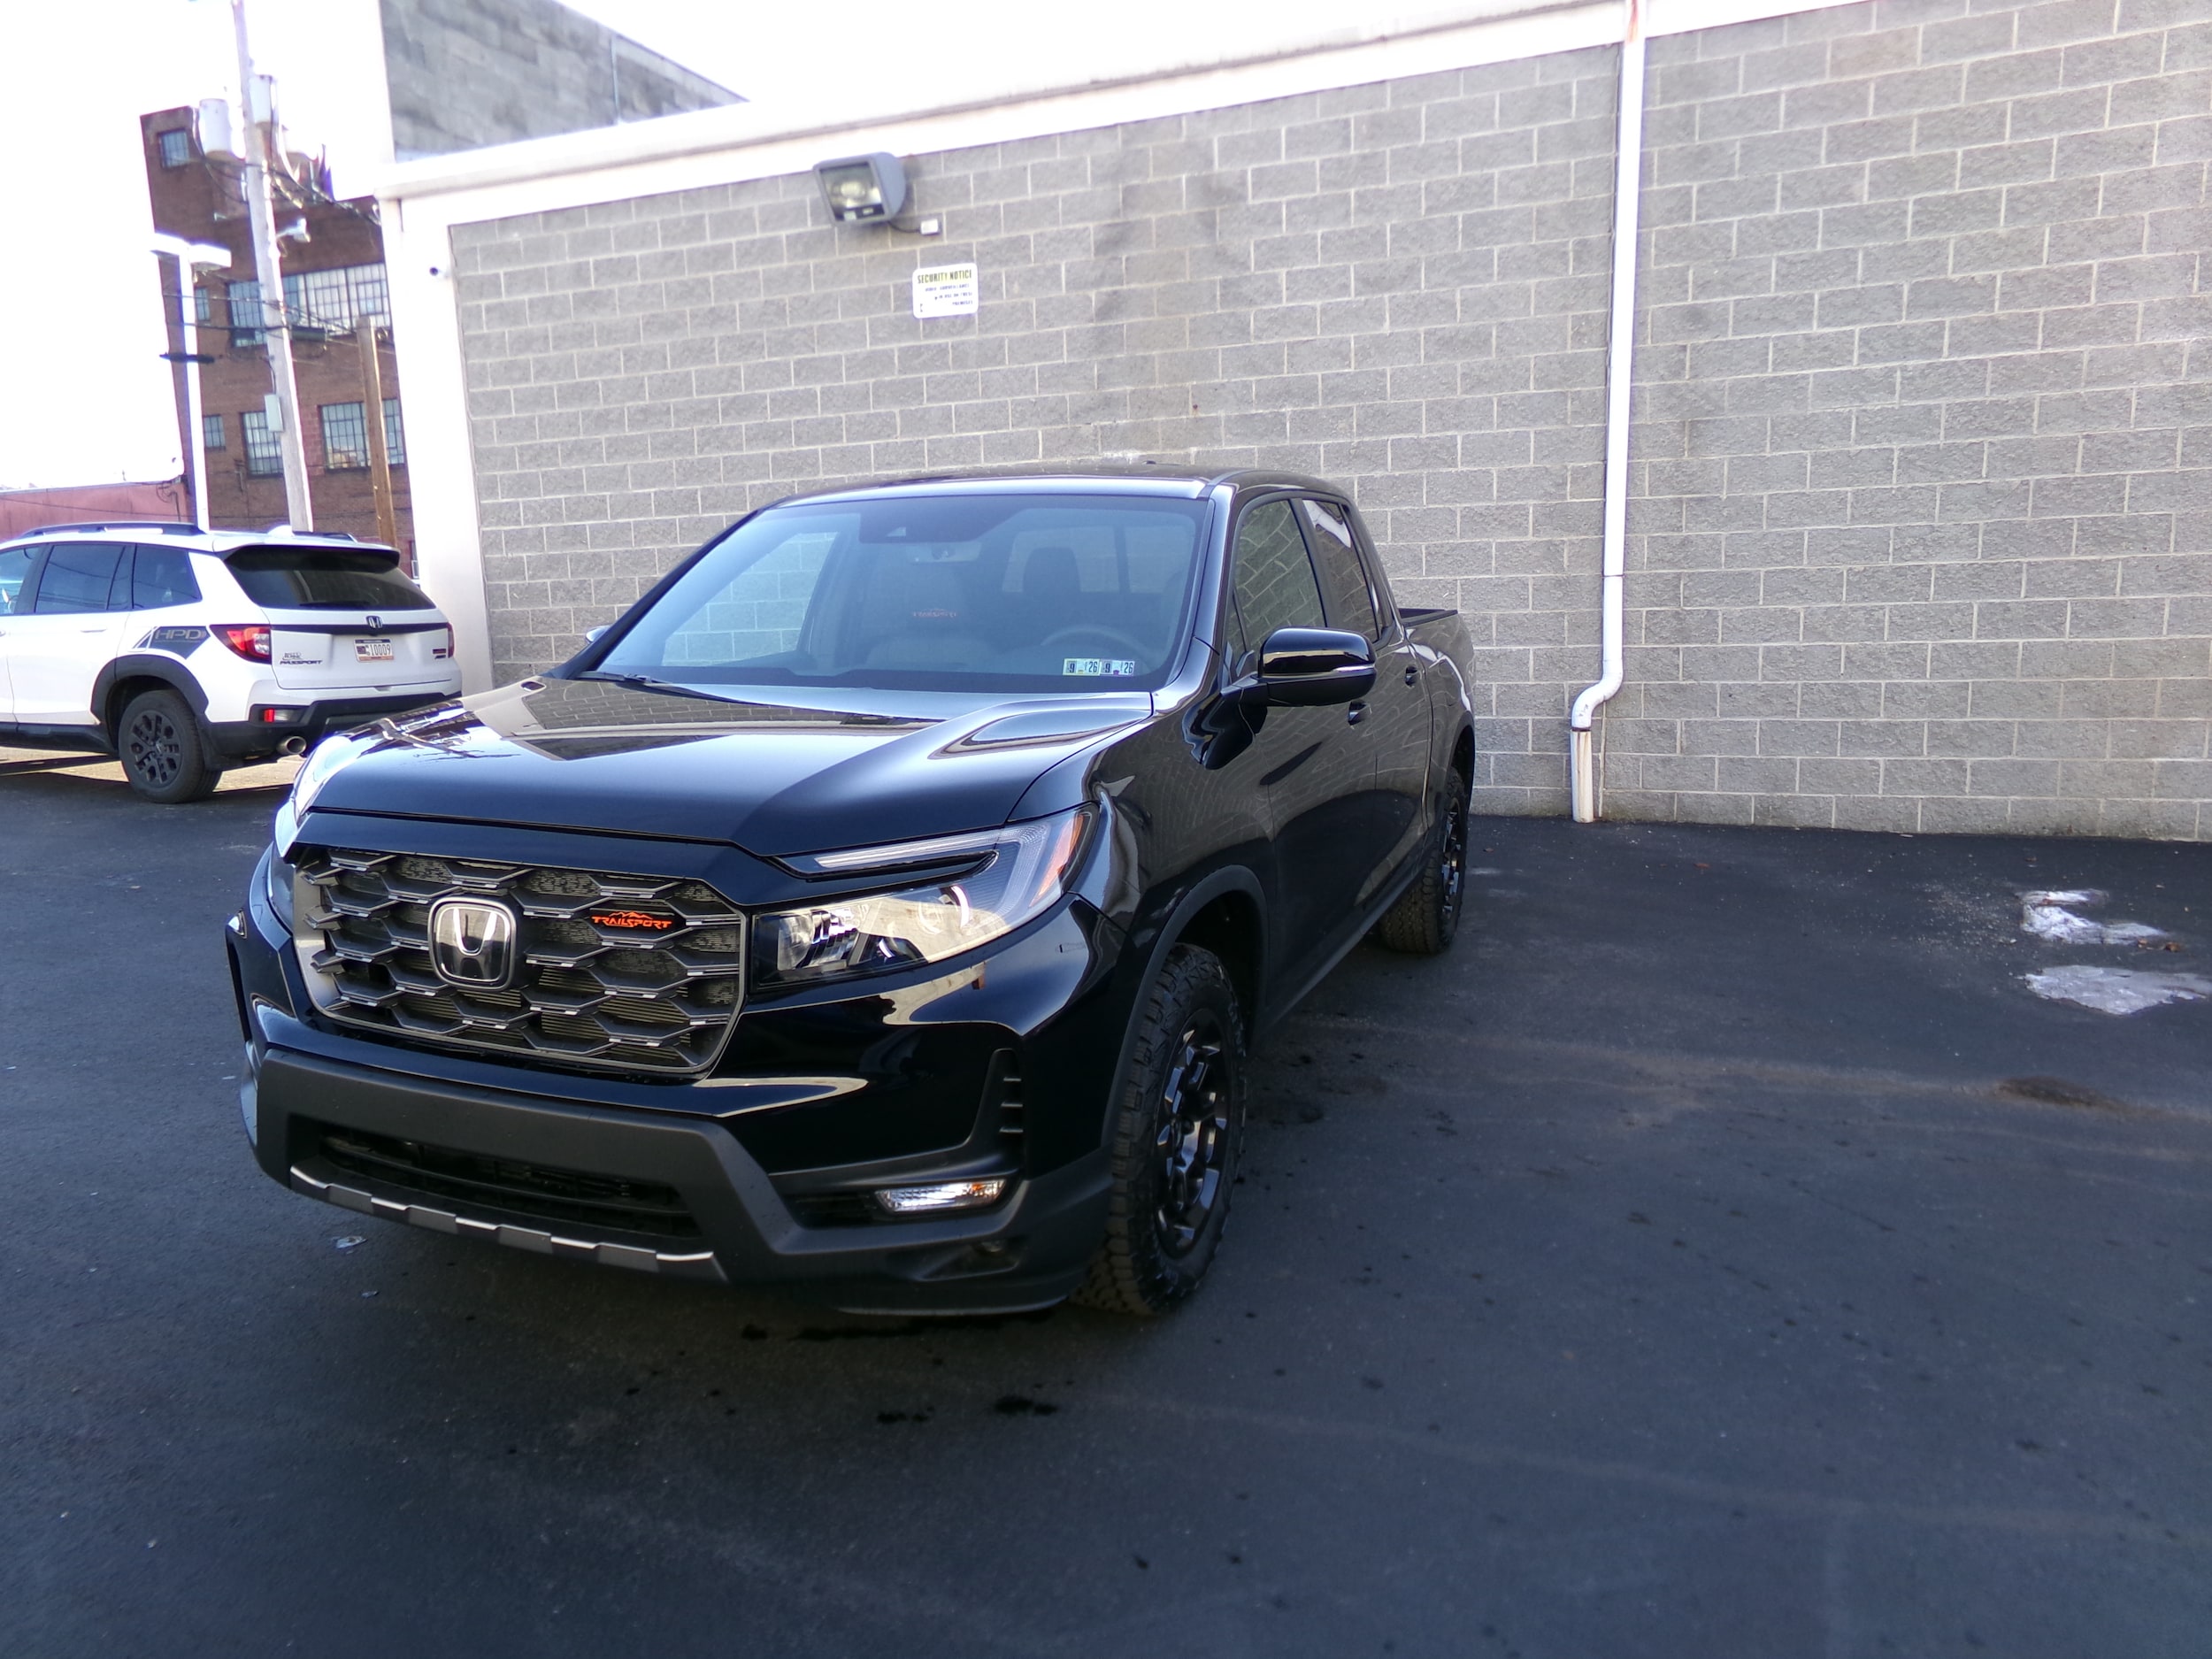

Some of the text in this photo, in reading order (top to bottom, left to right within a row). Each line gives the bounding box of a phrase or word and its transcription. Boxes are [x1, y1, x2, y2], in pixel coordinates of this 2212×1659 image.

[918, 273, 948, 284] SECURITY
[155, 629, 204, 640] HPD
[1069, 661, 1098, 673] 9 26
[1104, 662, 1133, 673] 9 26
[591, 916, 672, 930] TRAILSPORT
